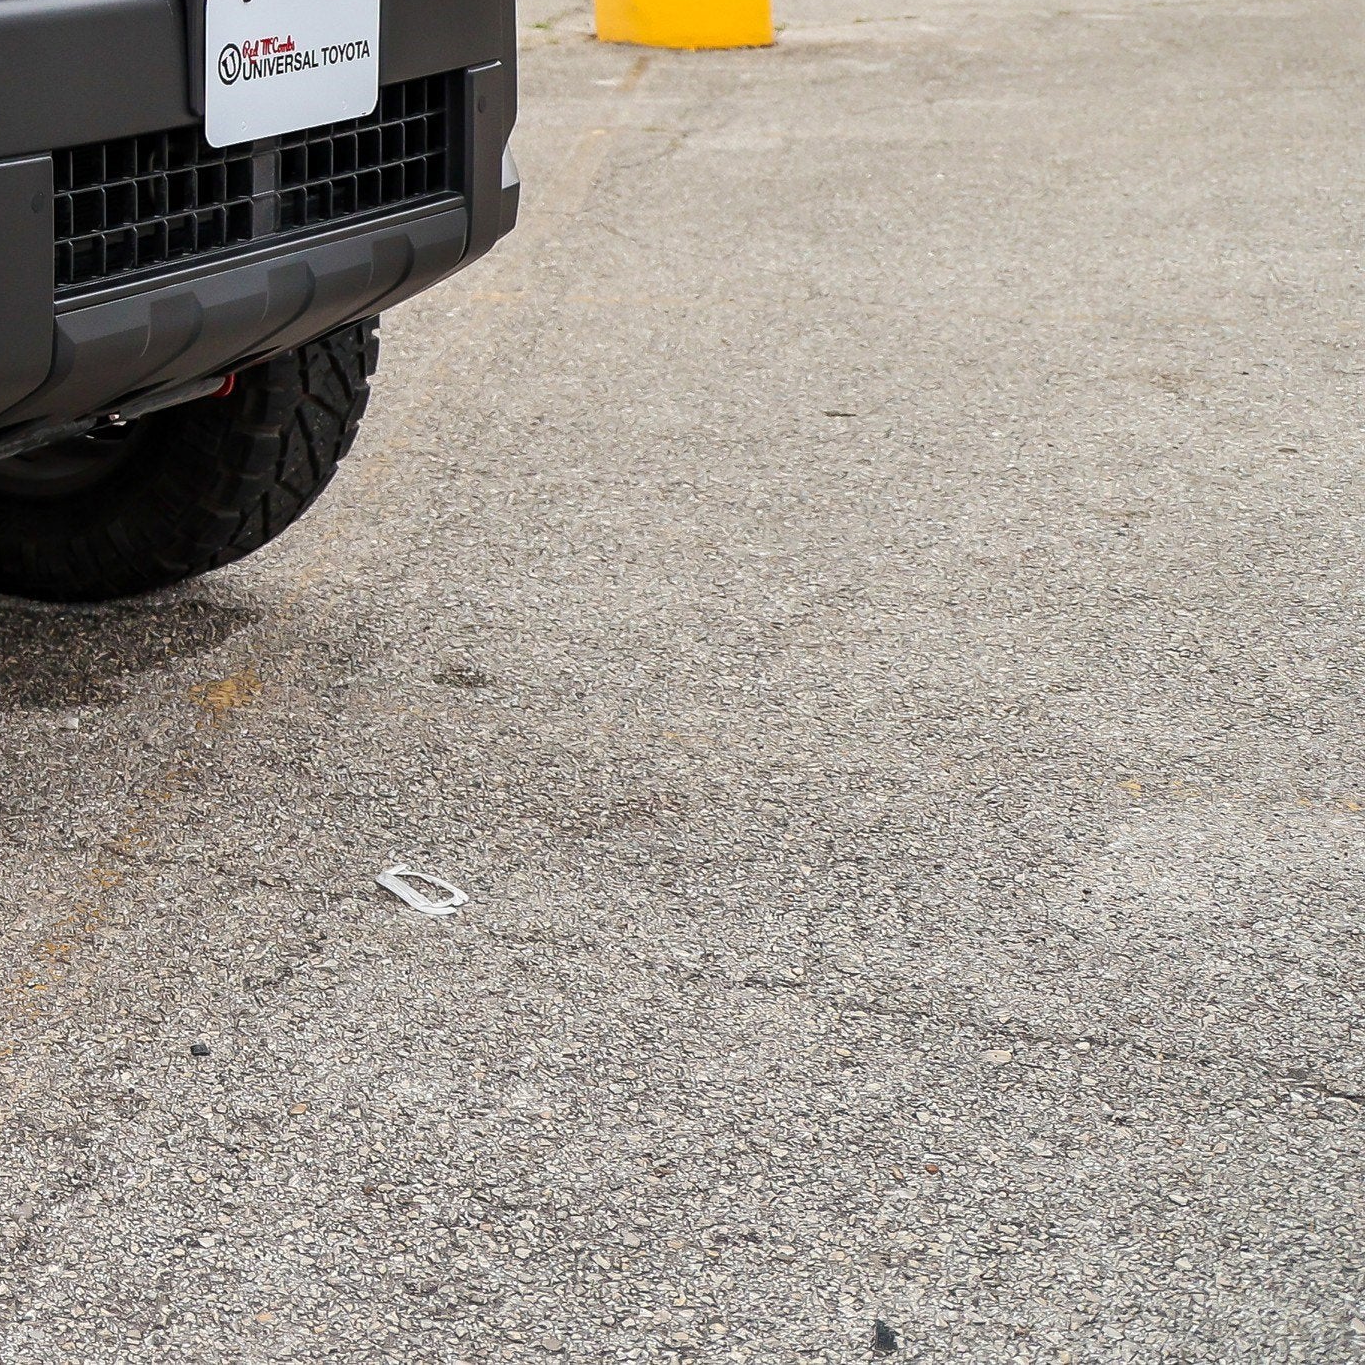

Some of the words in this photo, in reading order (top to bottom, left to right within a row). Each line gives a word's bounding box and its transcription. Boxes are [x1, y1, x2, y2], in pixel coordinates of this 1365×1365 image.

[242, 40, 260, 59] Red
[242, 50, 319, 81] UNIVERSAL
[321, 39, 371, 66] TOYOTA
